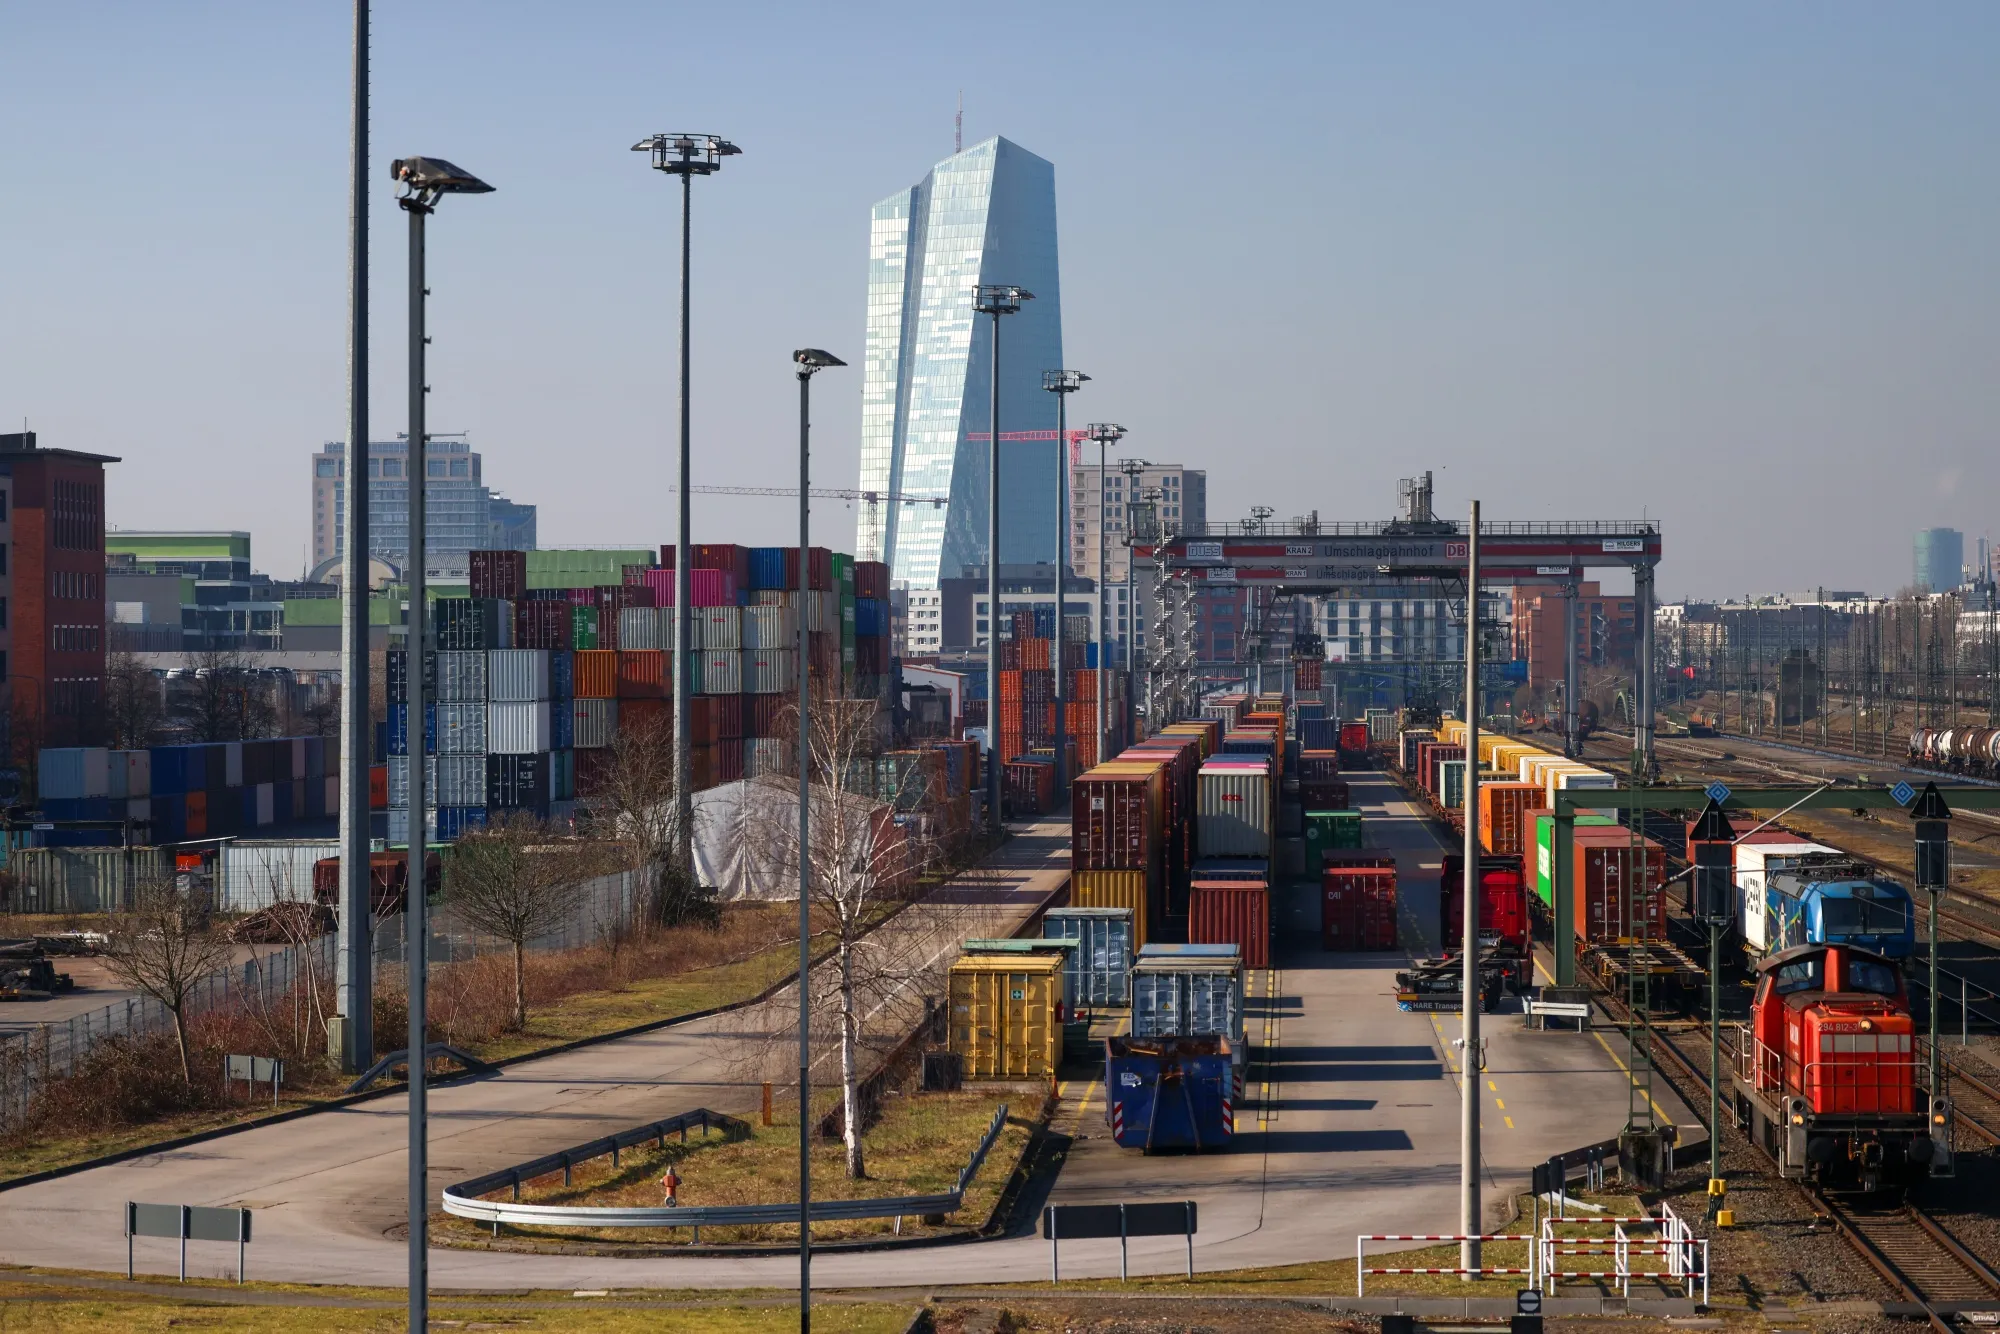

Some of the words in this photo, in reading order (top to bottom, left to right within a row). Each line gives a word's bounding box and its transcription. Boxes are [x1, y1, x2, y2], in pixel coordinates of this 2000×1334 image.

[1188, 546, 1220, 557] DUSS
[1286, 546, 1306, 555] KRAN
[1307, 546, 1312, 555] 2
[1324, 545, 1434, 560] Umschlagbahnhof
[1328, 891, 1341, 900] CAI
[1435, 1002, 1463, 1011] Transpo
[1818, 1022, 1834, 1032] 294
[1835, 1021, 1858, 1032] 812-3
